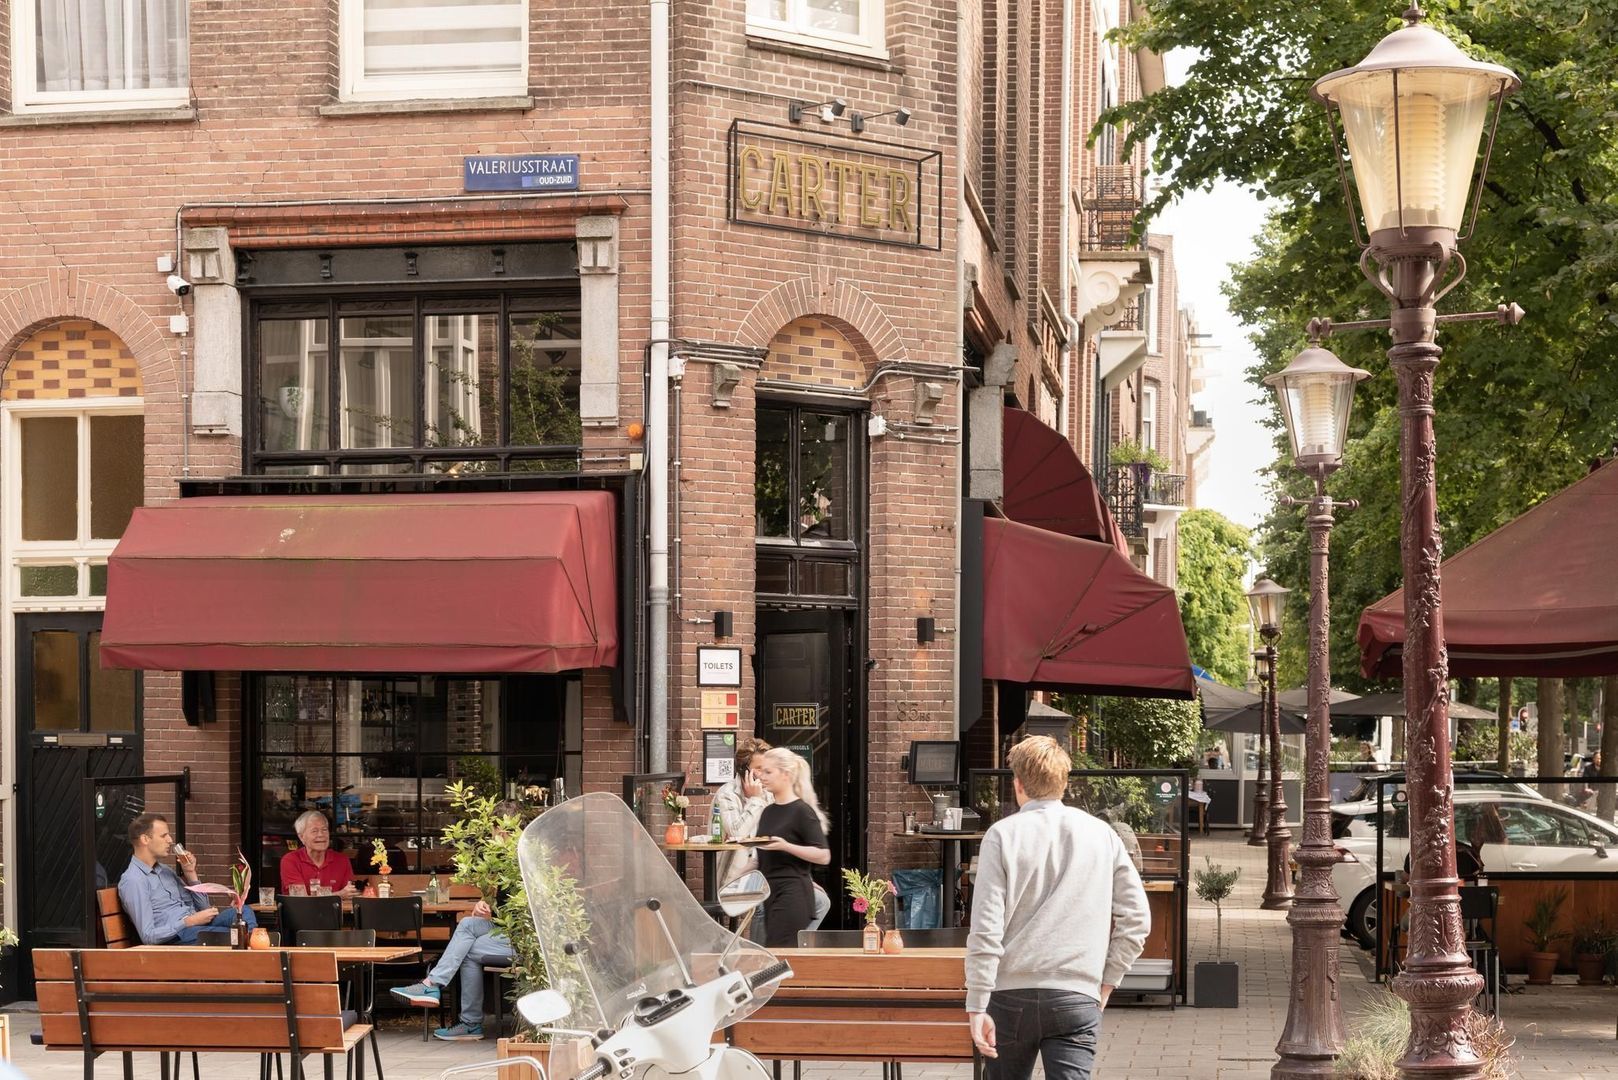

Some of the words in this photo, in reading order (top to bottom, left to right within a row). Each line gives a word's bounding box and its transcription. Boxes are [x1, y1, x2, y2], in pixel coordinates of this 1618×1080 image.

[469, 160, 574, 174] VALERIUSSTRAAT
[539, 176, 573, 185] OUD-ZUID
[739, 145, 912, 231] CARTER
[703, 662, 734, 670] TOILETS
[776, 707, 816, 725] CARTER
